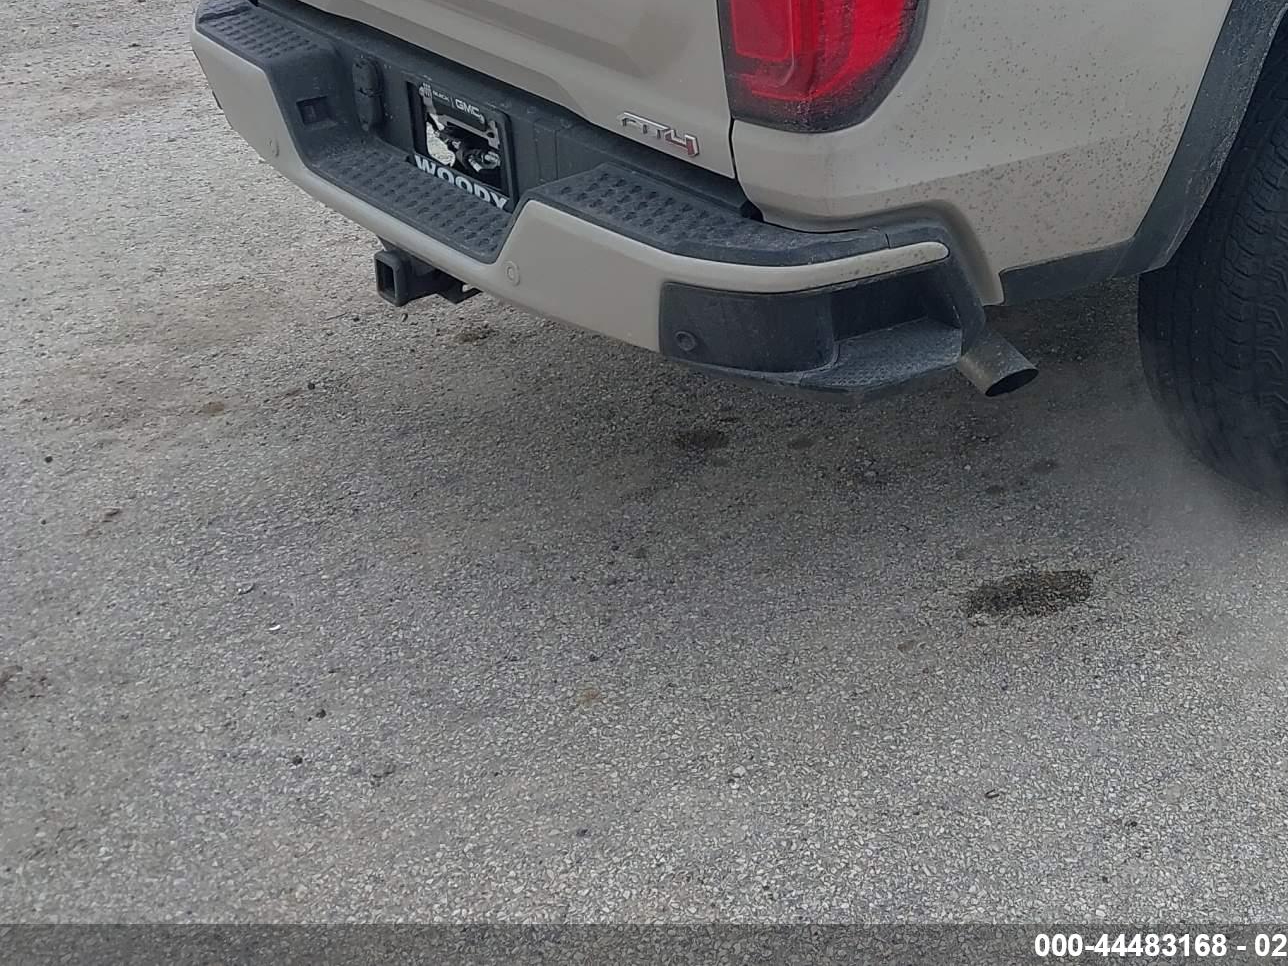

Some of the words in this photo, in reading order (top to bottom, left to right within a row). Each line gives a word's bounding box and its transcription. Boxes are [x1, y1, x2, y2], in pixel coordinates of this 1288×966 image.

[455, 98, 480, 118] GMC
[617, 111, 700, 157] AT4
[415, 154, 507, 209] WOODY
